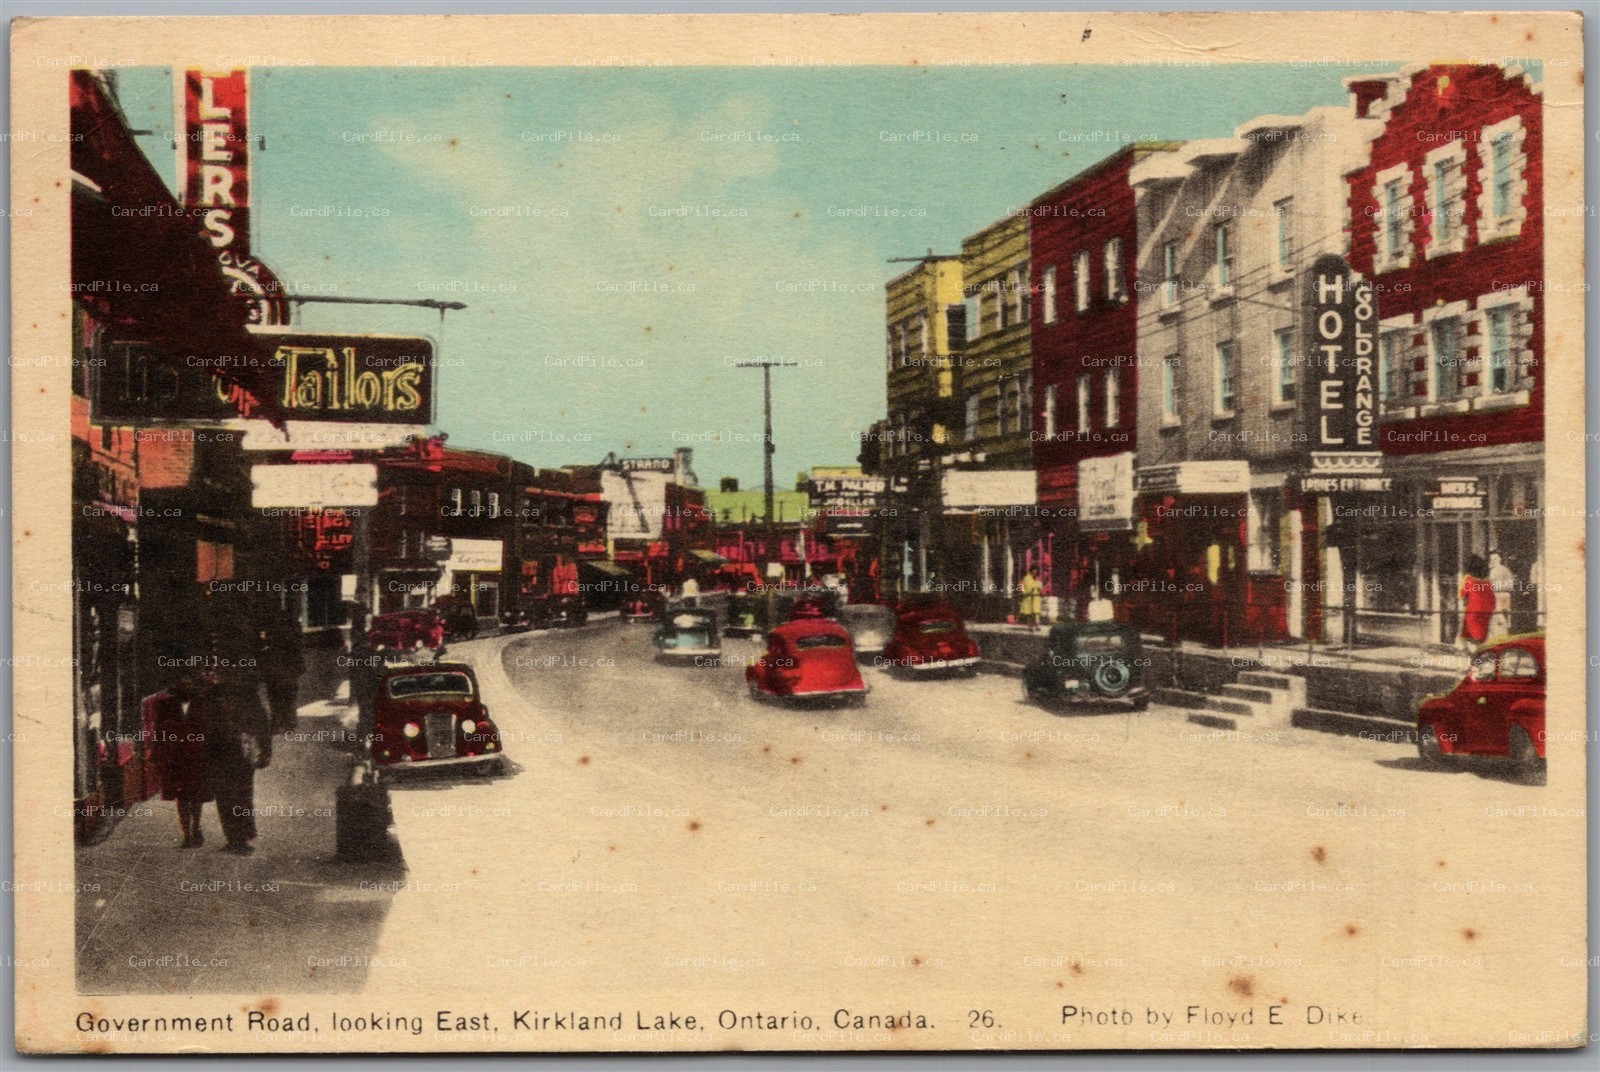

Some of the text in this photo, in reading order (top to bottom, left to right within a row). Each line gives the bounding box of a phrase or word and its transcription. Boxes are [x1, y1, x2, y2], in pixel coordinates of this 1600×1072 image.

[199, 67, 236, 248] LERS
[275, 345, 424, 411] Tailors
[1319, 274, 1344, 444] HOTEL
[1355, 285, 1373, 445] GOLDRANGE
[622, 459, 670, 470] STRAND
